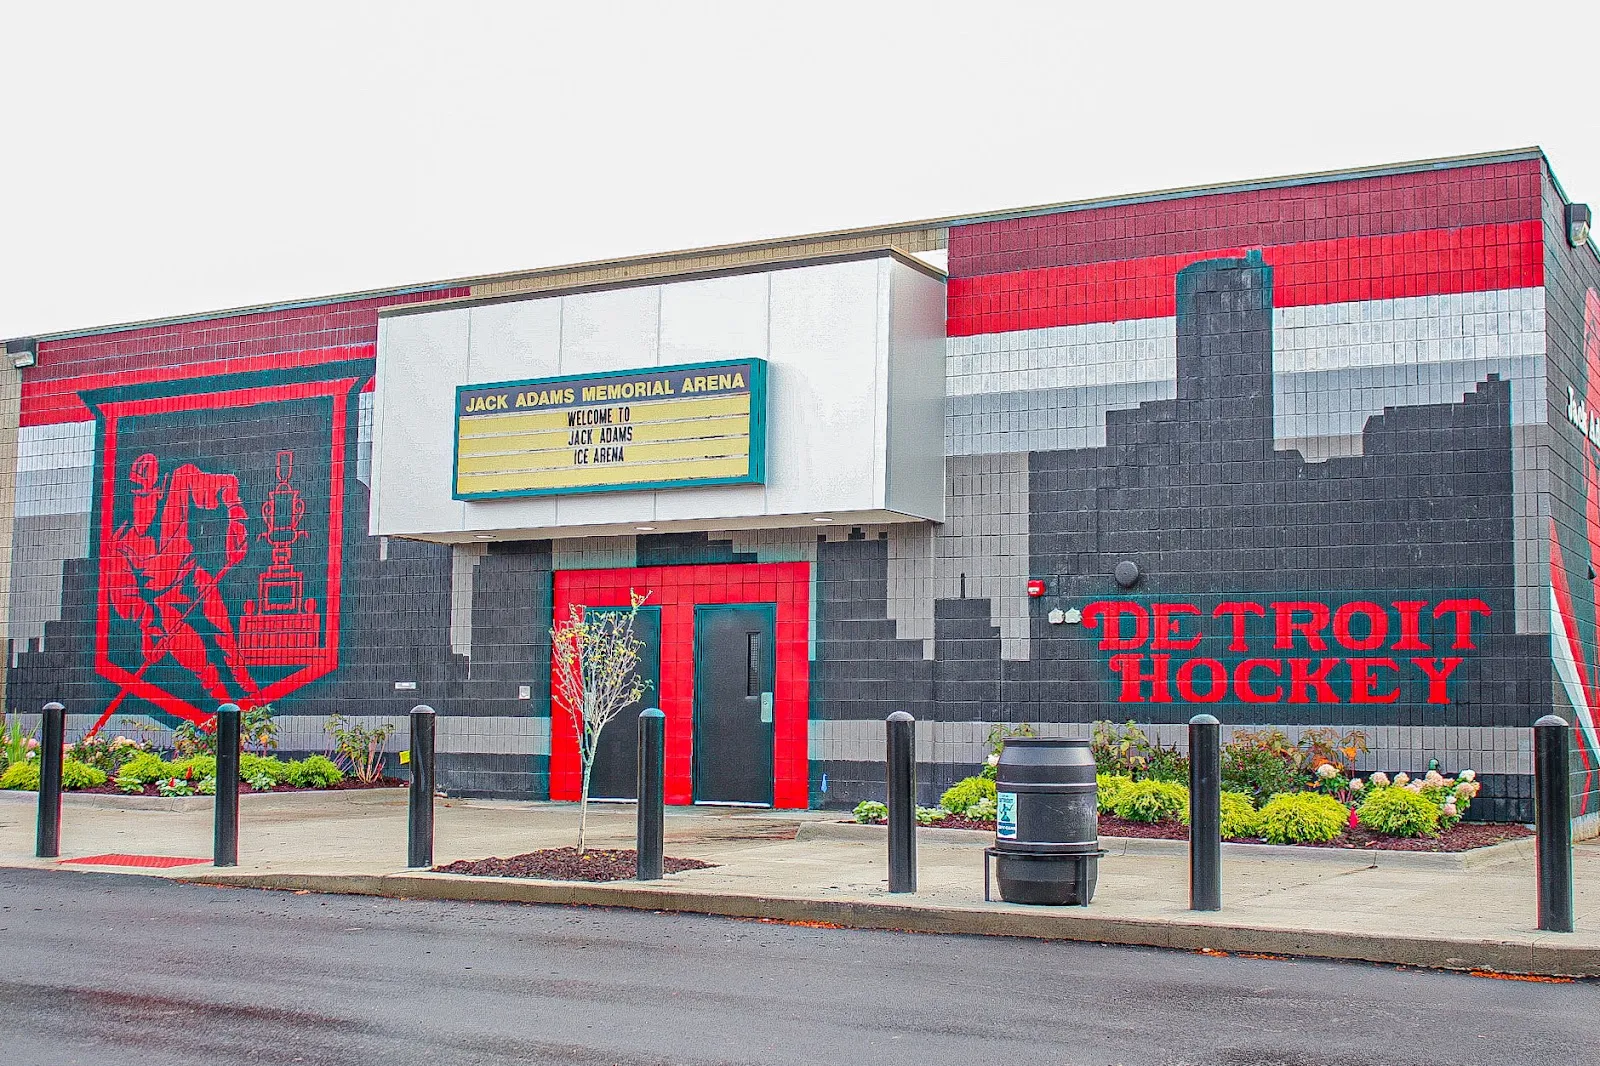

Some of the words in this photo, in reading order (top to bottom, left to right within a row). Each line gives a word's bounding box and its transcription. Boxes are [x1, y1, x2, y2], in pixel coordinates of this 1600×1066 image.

[465, 394, 508, 412] JACK
[515, 388, 575, 408] ADAMS
[581, 381, 674, 403] MEMORIAL
[681, 373, 745, 393] ARENA
[568, 408, 613, 427] WELCOME
[618, 406, 630, 423] TO
[568, 428, 593, 446] JACK
[600, 426, 633, 444] ADAMS
[574, 448, 589, 465] ICE
[593, 446, 624, 464] ARENA
[1082, 598, 1492, 652] DETROIT
[1109, 653, 1464, 704] HOCKEY
